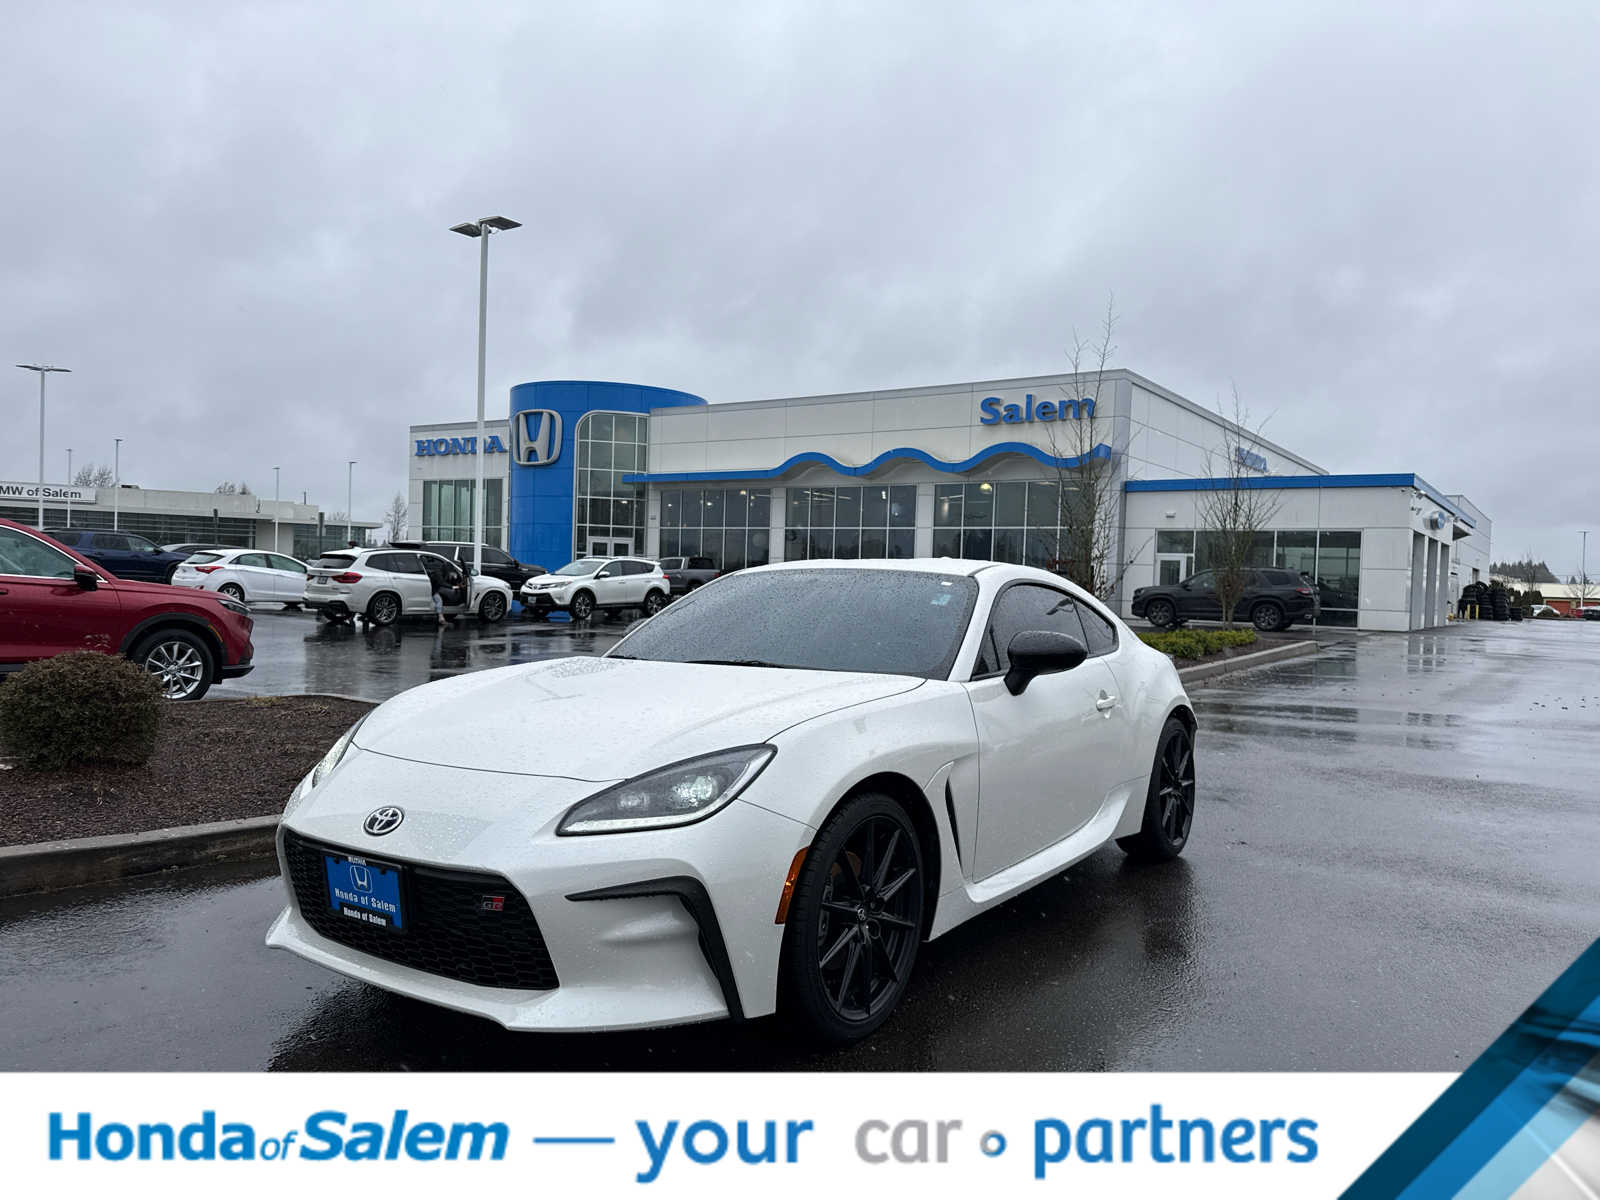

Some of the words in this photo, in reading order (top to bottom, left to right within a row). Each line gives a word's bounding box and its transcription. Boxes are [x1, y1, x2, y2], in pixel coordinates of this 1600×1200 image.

[980, 394, 1096, 425] Salem
[26, 488, 39, 496] of
[42, 488, 81, 498] Salem
[335, 888, 358, 902] Honda
[361, 896, 368, 905] of
[371, 898, 396, 912] Salem
